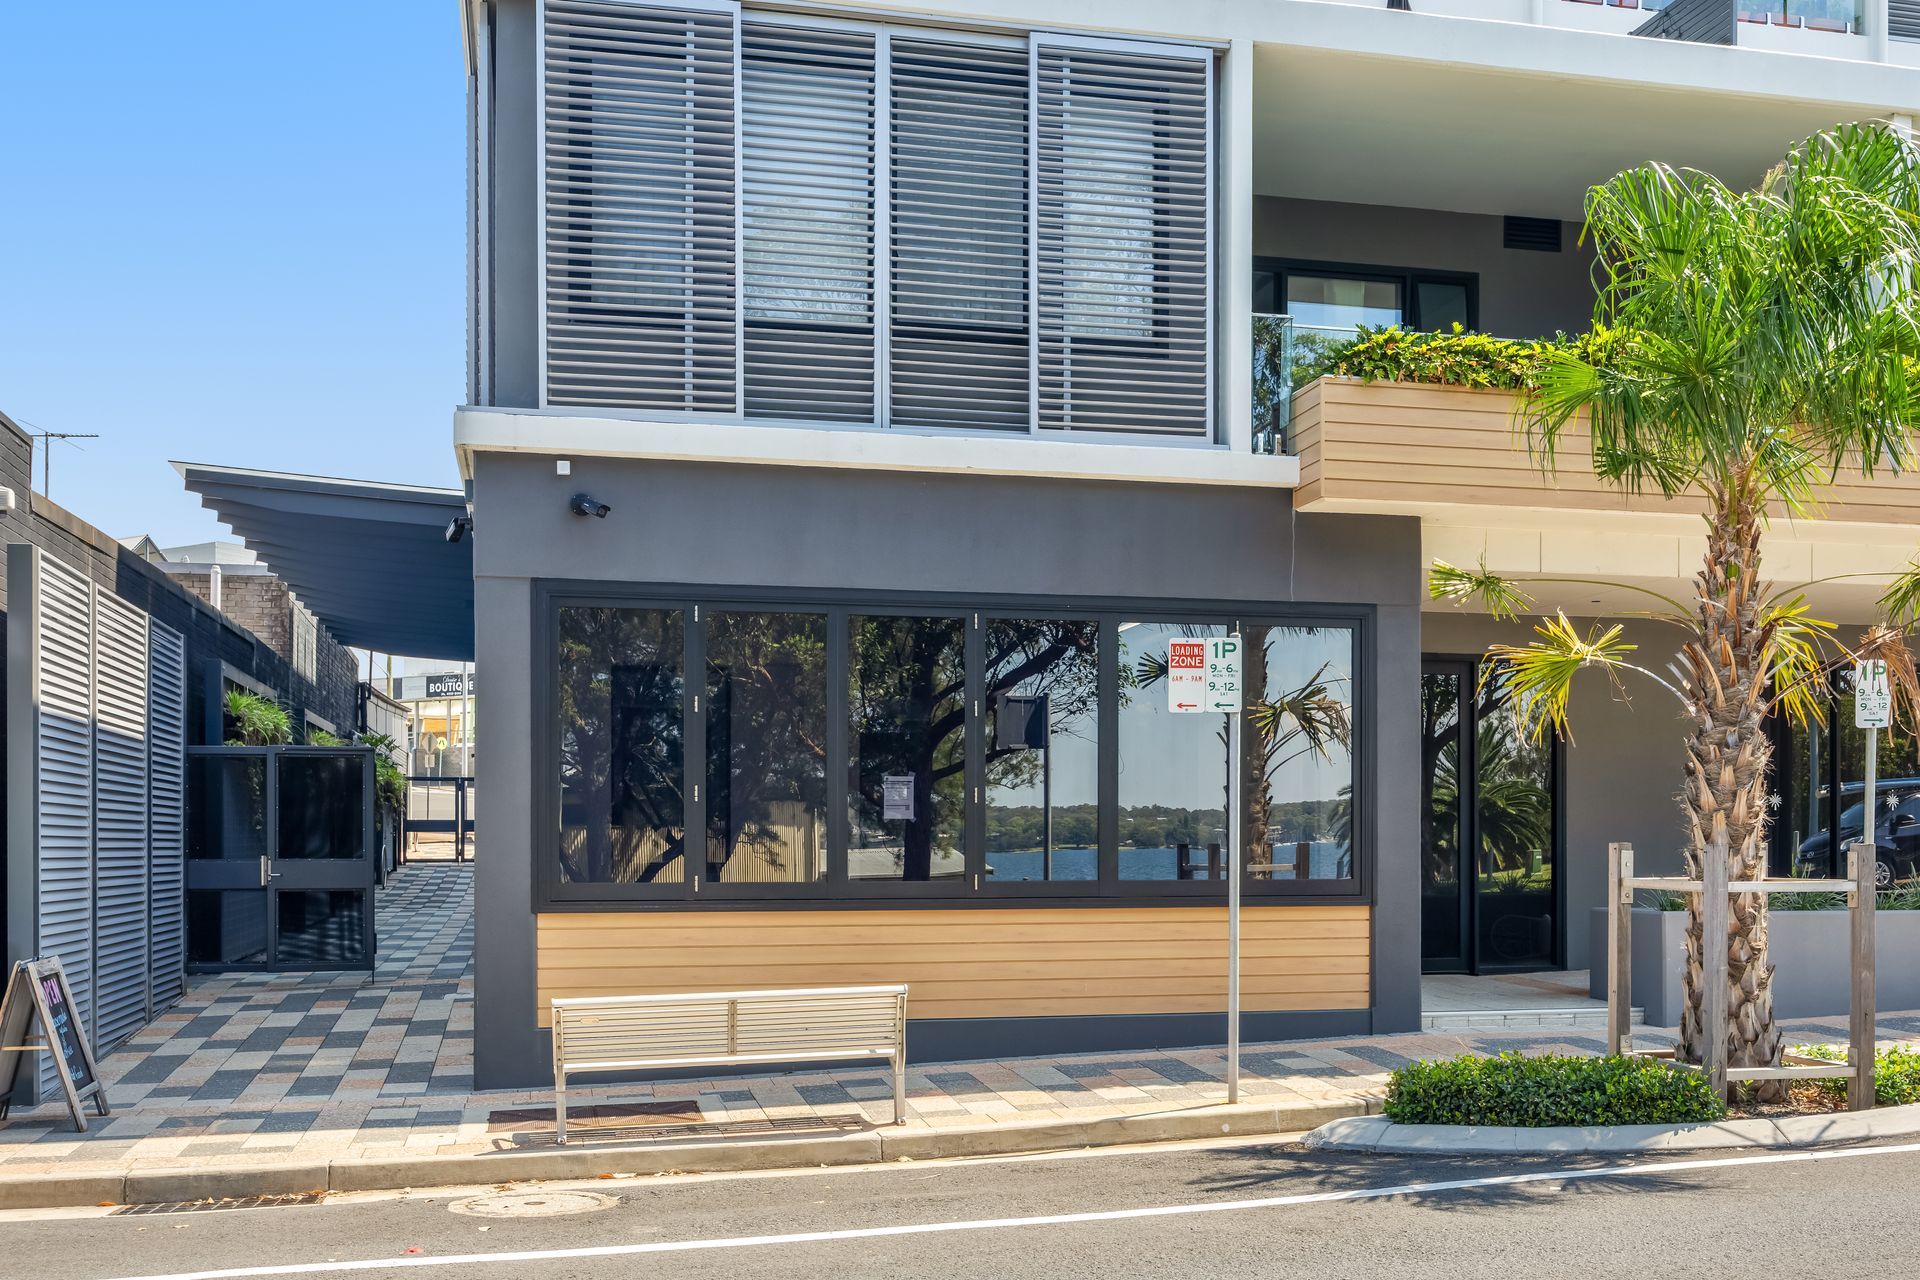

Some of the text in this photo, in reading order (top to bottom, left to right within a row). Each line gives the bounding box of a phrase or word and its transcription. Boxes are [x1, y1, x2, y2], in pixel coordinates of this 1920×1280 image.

[1171, 645, 1204, 656] LOADING
[1212, 641, 1237, 659] 1P
[1171, 656, 1204, 667] ZONE
